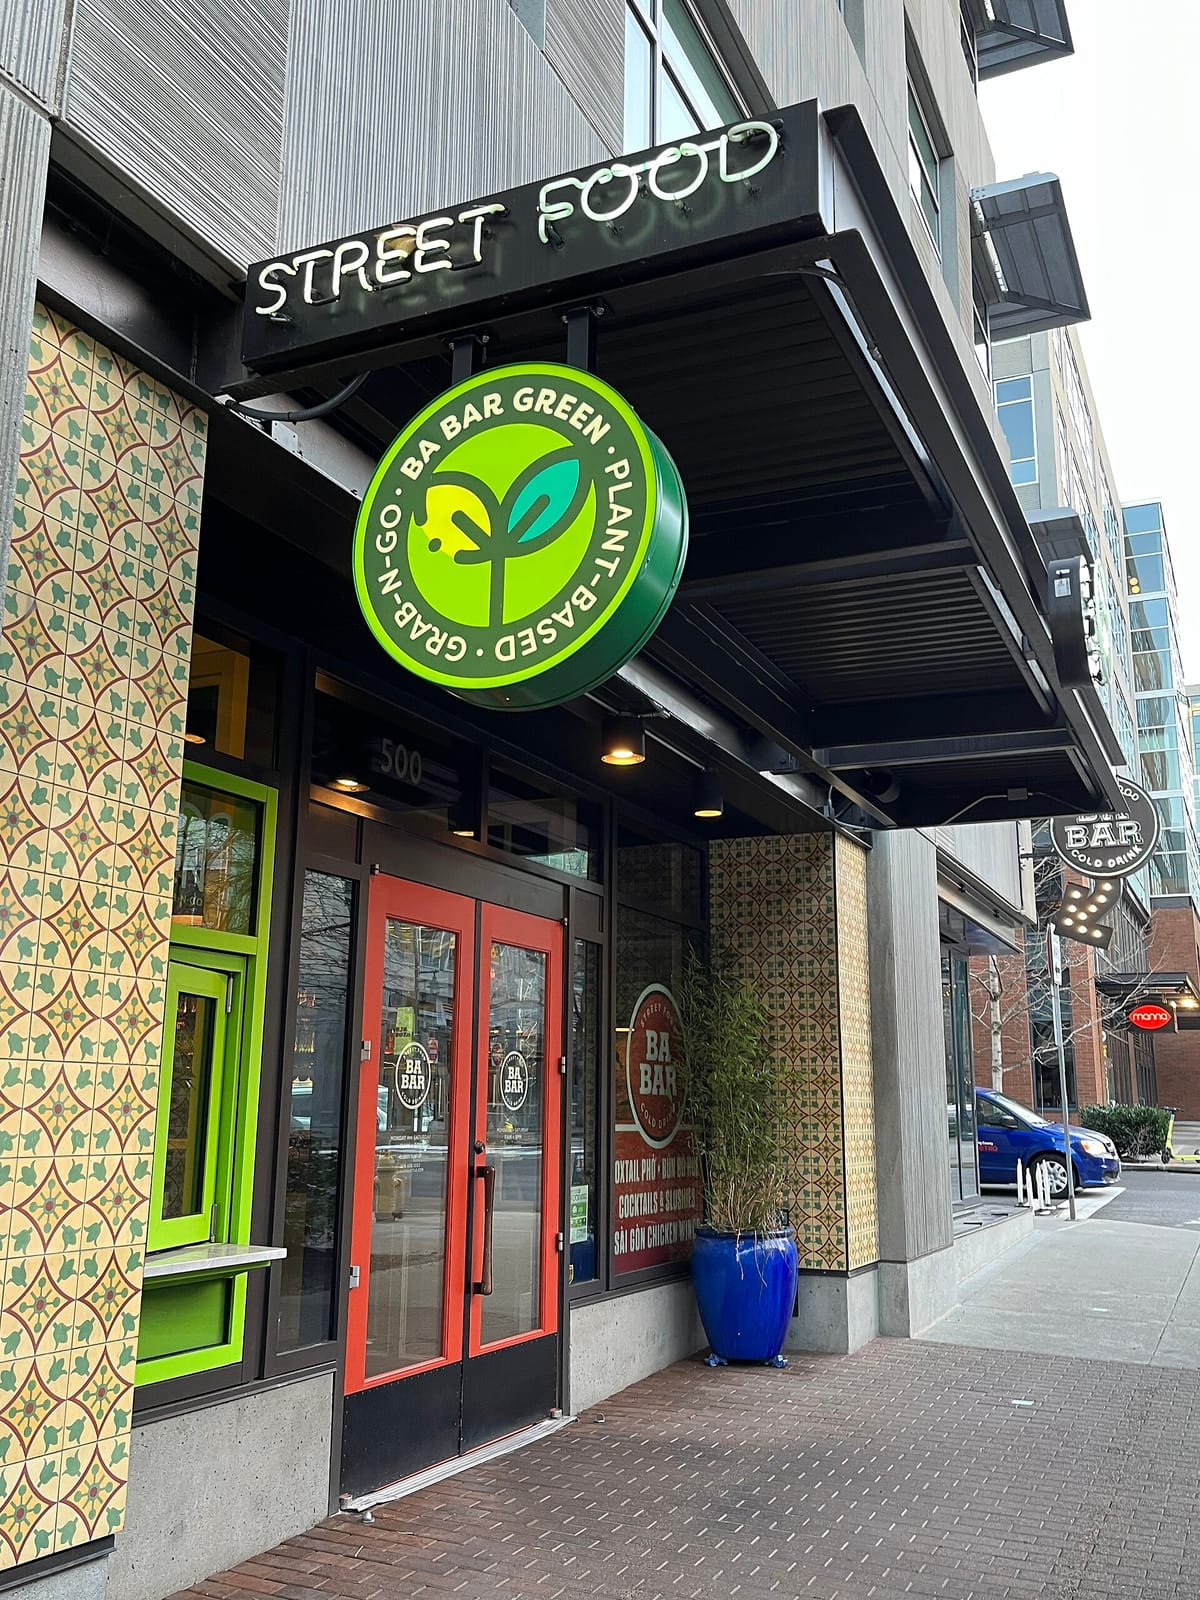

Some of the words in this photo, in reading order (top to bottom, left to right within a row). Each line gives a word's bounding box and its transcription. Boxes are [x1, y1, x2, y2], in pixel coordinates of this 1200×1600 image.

[255, 203, 505, 316] STREET
[537, 120, 780, 244] FOOD
[400, 439, 441, 481] BA
[439, 393, 504, 440] BAR
[512, 387, 611, 445] GREEN
[494, 458, 633, 662] PLANT-BASED
[376, 503, 467, 662] GRAB-N-GO
[380, 737, 422, 785] 500
[1118, 784, 1140, 802] OOD
[1064, 820, 1144, 850] BAR
[1071, 849, 1103, 868] COLD
[1107, 845, 1143, 869] DRINK
[645, 1029, 672, 1062] BA
[405, 1059, 421, 1074] BA
[508, 1066, 521, 1080] BA
[639, 1062, 678, 1097] BAR
[401, 1074, 425, 1090] BAR
[504, 1080, 524, 1094] BAR
[640, 1102, 656, 1128] COLD
[614, 1159, 639, 1184] OXTAIL
[618, 1191, 658, 1219] COCKTAILS
[665, 1187, 696, 1212] SLUSHIES
[647, 1221, 677, 1249] CHICKEN
[678, 1218, 700, 1243] WING
